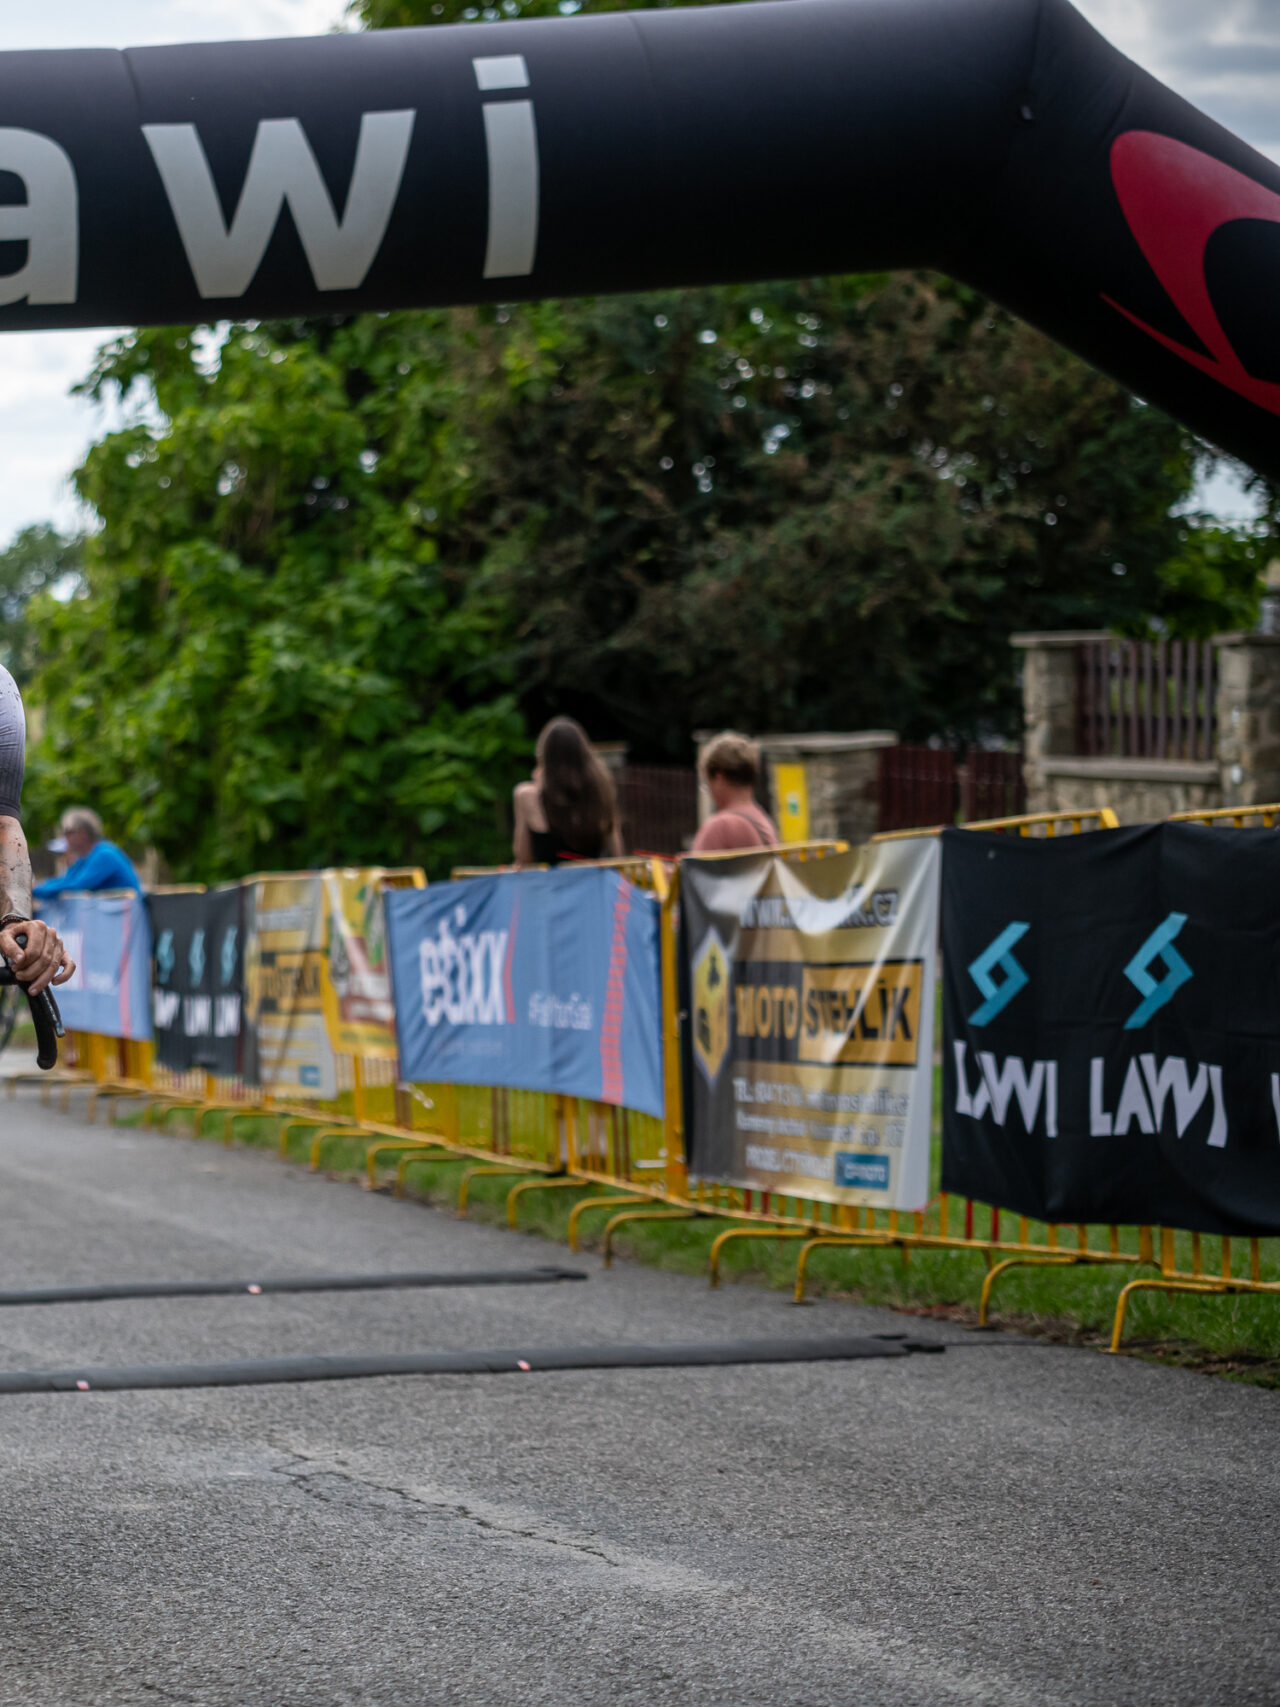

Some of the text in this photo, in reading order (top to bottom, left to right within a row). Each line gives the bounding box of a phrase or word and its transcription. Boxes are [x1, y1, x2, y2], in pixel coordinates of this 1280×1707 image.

[735, 985, 799, 1039] MOTO
[953, 1039, 1058, 1138] LAWI
[1090, 1053, 1228, 1148] LAWI
